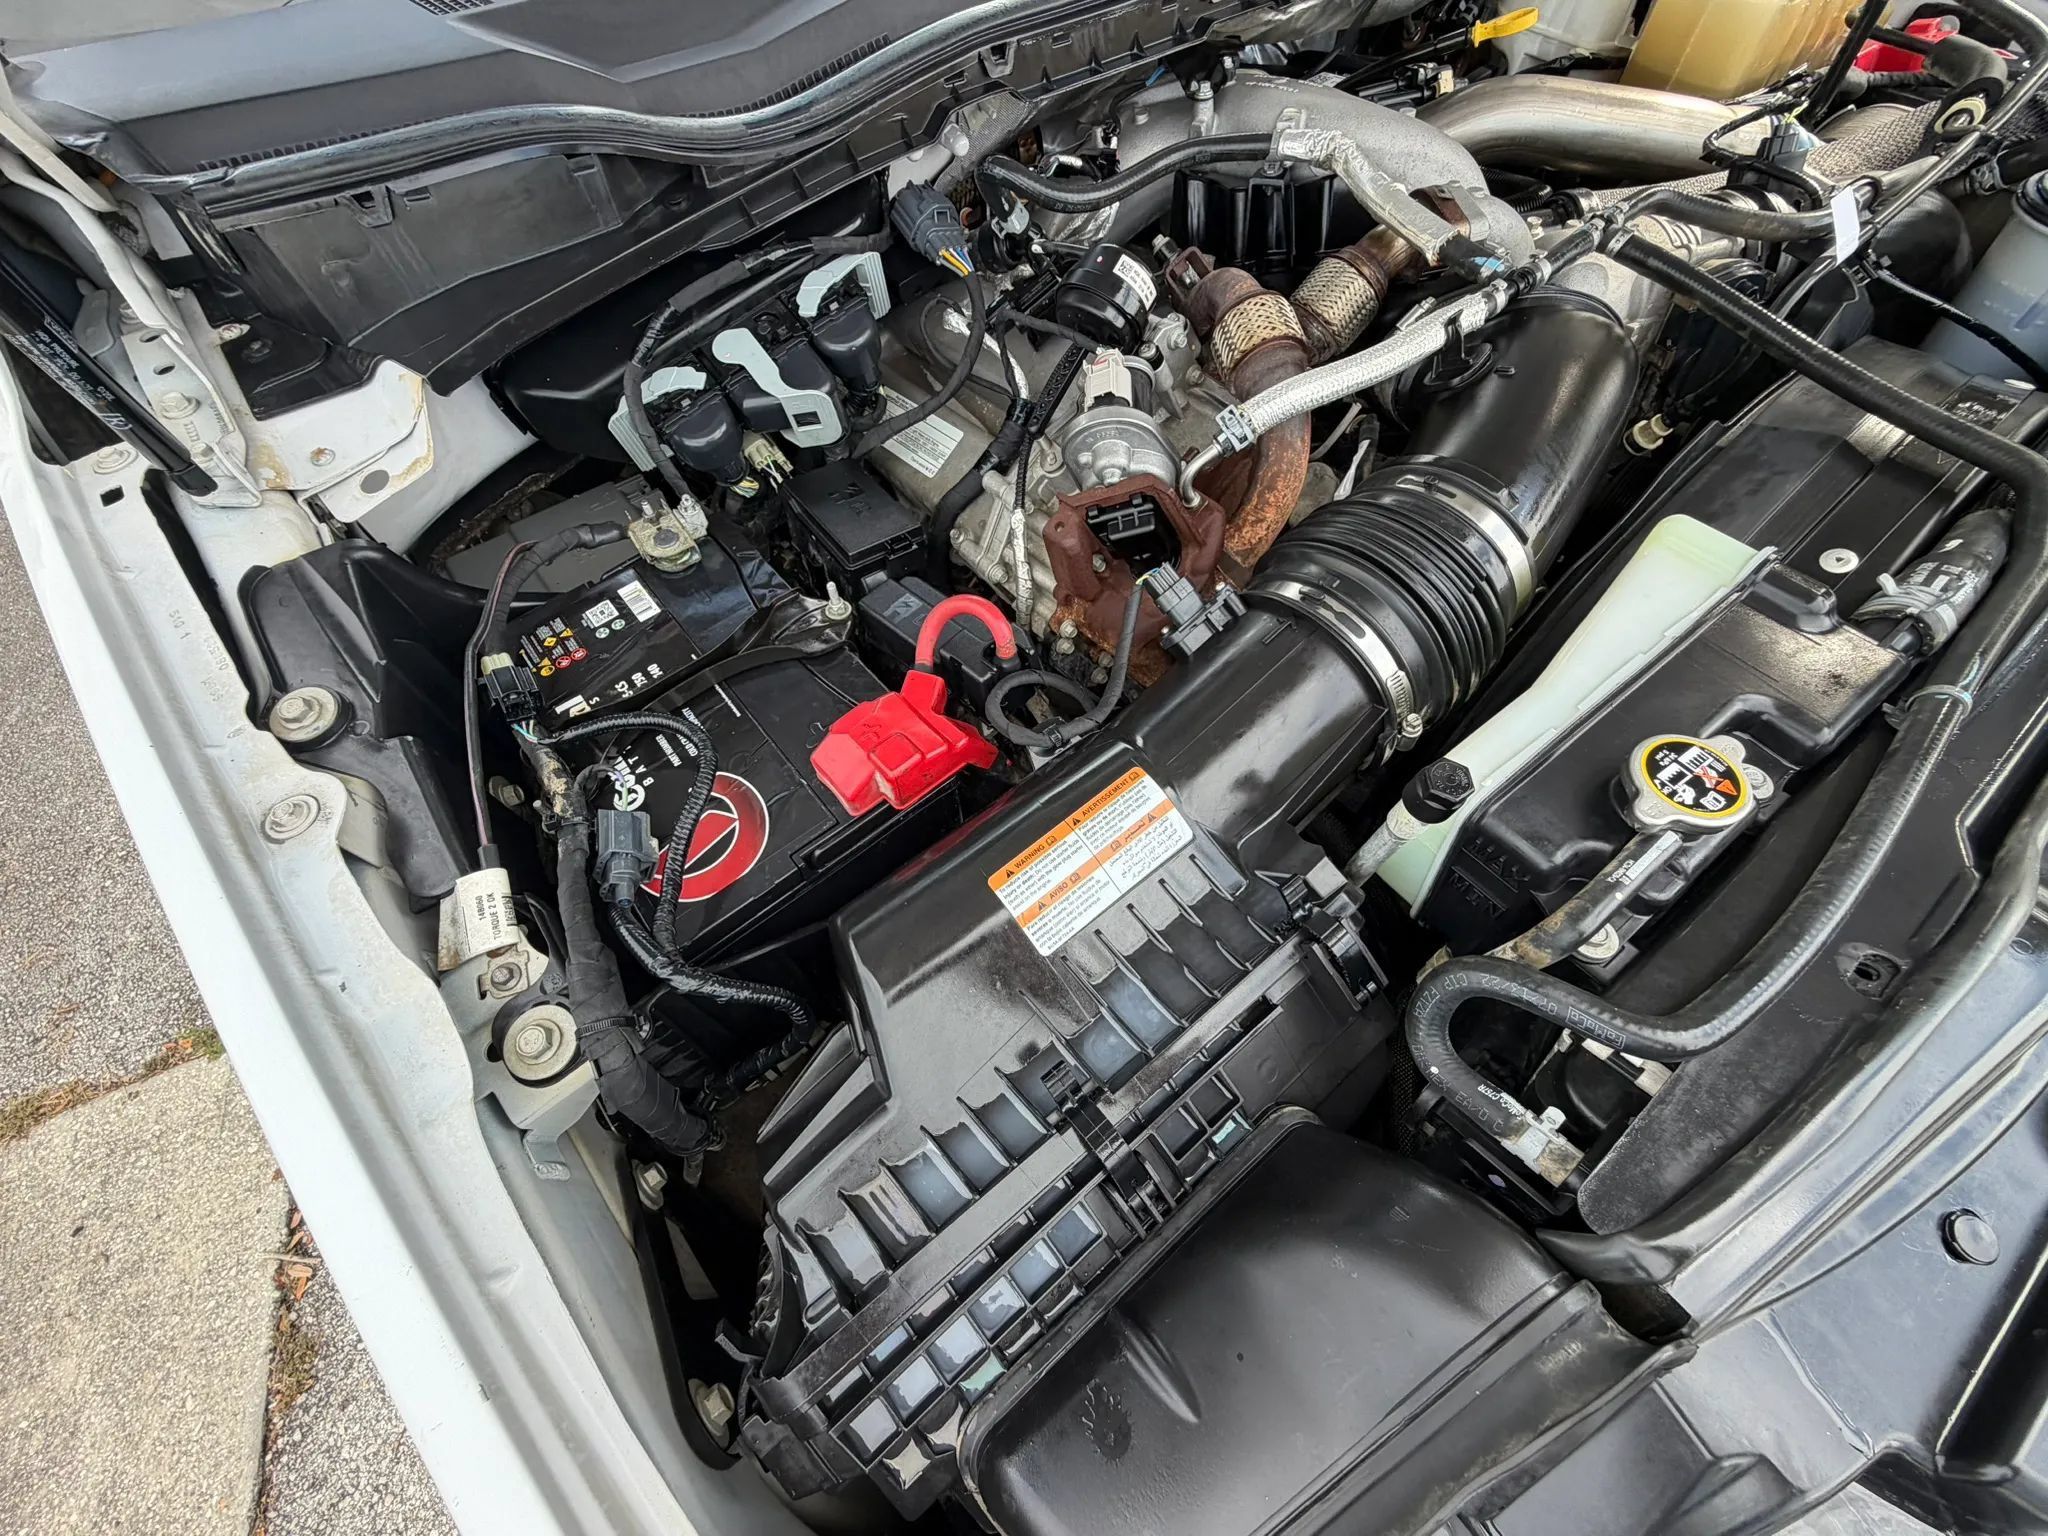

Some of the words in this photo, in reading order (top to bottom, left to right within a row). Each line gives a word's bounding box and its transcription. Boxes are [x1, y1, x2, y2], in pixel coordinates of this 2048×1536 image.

[630, 670, 648, 688] 750
[646, 662, 664, 679] 140
[654, 733, 675, 756] NUMBER
[684, 741, 698, 757] COLD
[667, 752, 682, 767] PART
[1080, 777, 1130, 817] AVERTISSEMENT
[1013, 842, 1046, 870] WARNING
[1467, 836, 1531, 889] MAX
[486, 891, 495, 902] OK
[1046, 880, 1069, 900] AVISO
[1446, 871, 1504, 920] MIN
[489, 910, 501, 939] TORQUE
[1568, 1009, 1624, 1046] FoMoCo
[1476, 1082, 1501, 1100] C757R
